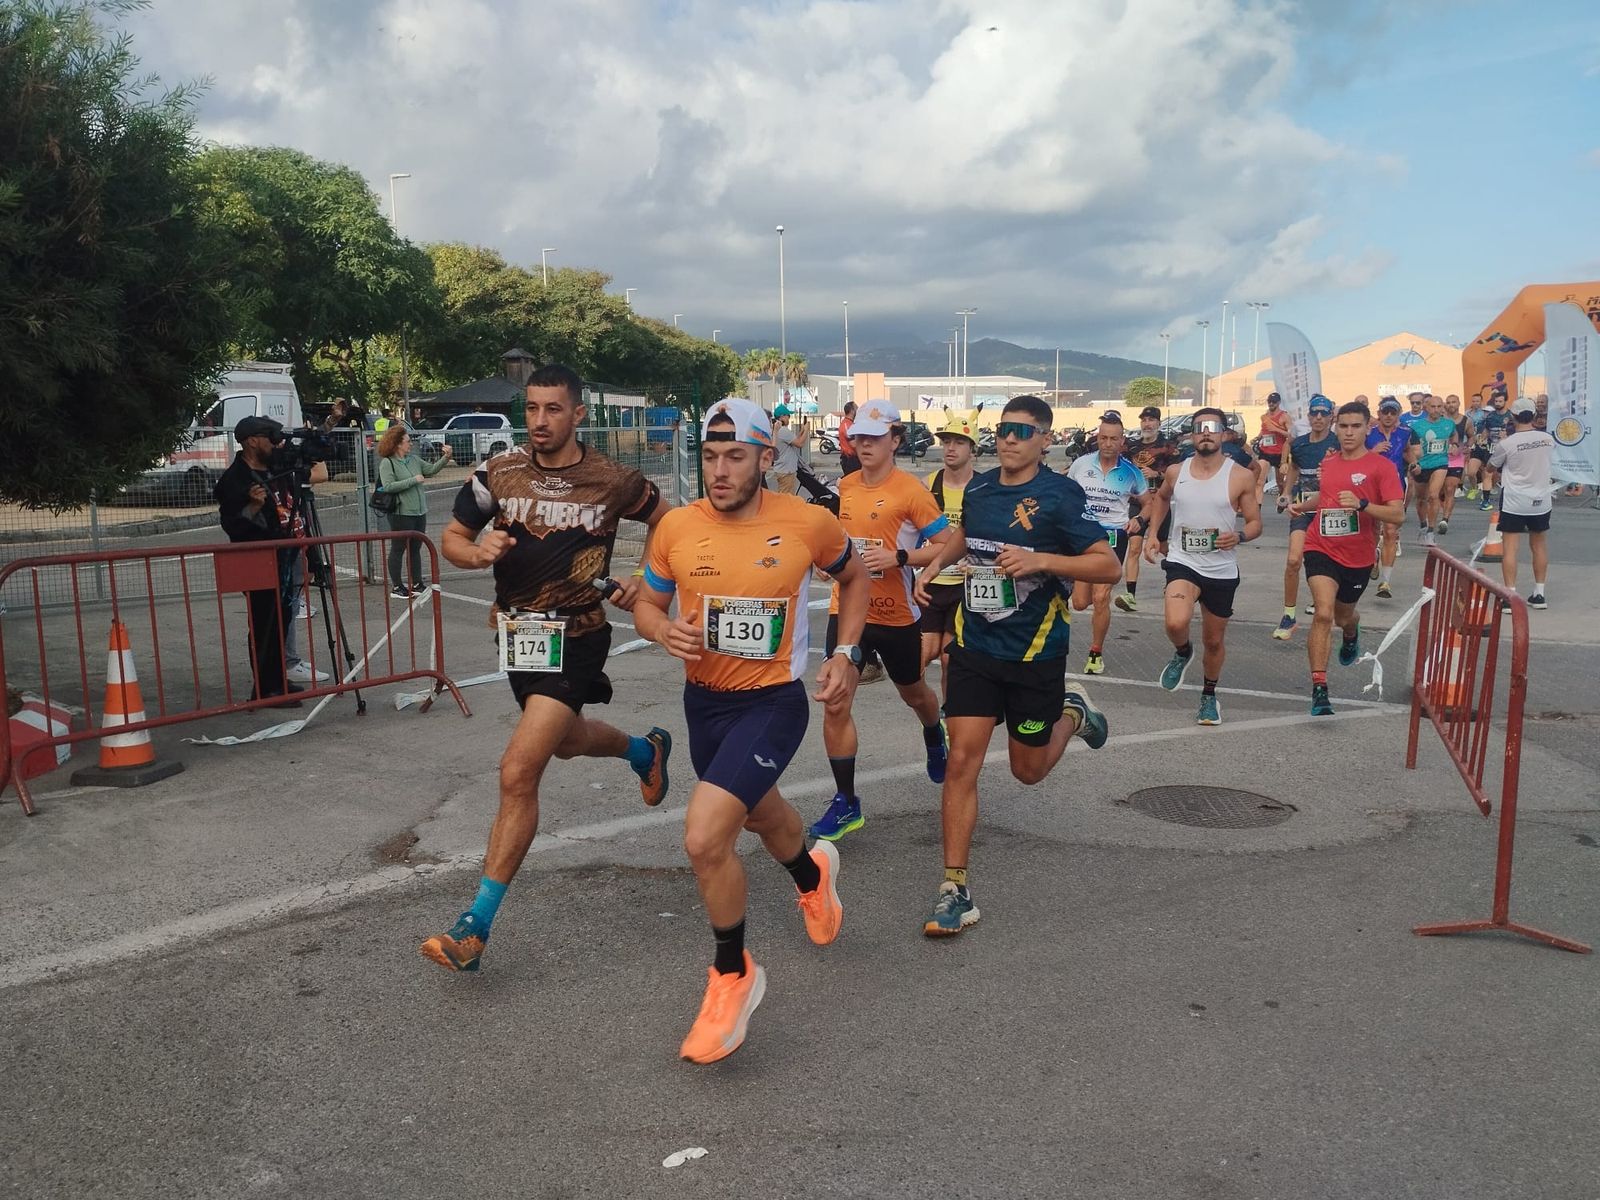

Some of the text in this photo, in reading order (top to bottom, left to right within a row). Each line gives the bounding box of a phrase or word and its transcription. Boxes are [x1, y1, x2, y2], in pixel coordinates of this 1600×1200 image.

[273, 404, 284, 416] 112
[1090, 504, 1110, 514] CEUTA
[1328, 519, 1347, 529] 116
[1188, 537, 1208, 547] 138
[973, 584, 998, 599] 121
[735, 608, 779, 616] FORTALEZA
[725, 621, 765, 641] 130
[519, 641, 547, 656] 174
